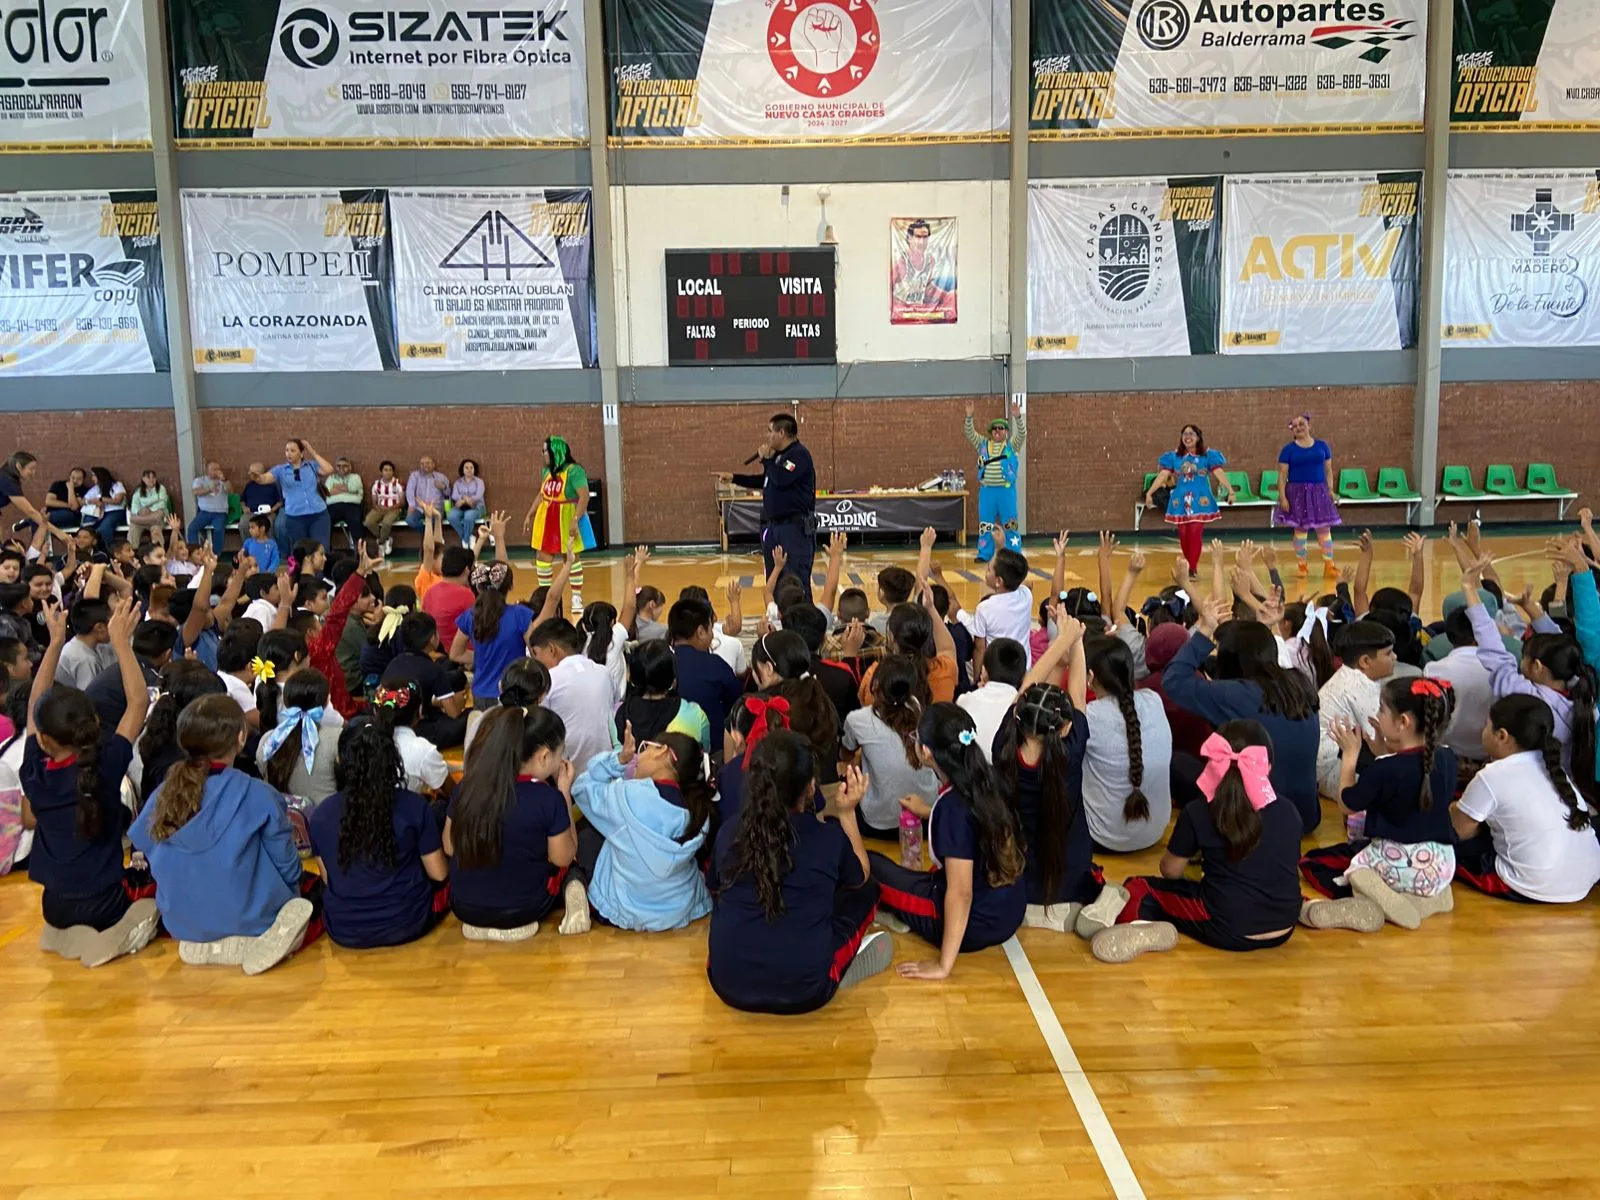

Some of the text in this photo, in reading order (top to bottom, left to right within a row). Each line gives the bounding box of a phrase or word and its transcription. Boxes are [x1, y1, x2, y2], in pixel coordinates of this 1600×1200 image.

[1194, 0, 1385, 28] Autopartes
[0, 0, 107, 63] olor
[348, 11, 569, 42] SIZATEK
[1201, 31, 1306, 47] Balderrama
[350, 46, 571, 67] Internet por Fibra Óptica
[1035, 71, 1117, 89] PATROCINADOR
[1458, 66, 1539, 82] PATROCINADOR
[184, 81, 268, 97] PATROCINADOR
[618, 79, 699, 95] PATROCINADOR
[1149, 77, 1227, 93] 636-661-3473
[1234, 75, 1307, 92] 636-694-1322
[1032, 88, 1117, 120] OFICIAL
[1454, 82, 1540, 113] OFICIAL
[183, 97, 271, 129] OFICIAL
[616, 95, 702, 127] OFICIAL
[765, 103, 814, 111] GOBIERNO
[818, 102, 868, 110] MUNICIPAL
[765, 109, 885, 119] NUEVO CASAS GRANDES
[99, 214, 160, 237] OFICIAL
[1087, 202, 1163, 263] CASAS GRANDES
[213, 251, 372, 277] POMPEII
[1511, 264, 1569, 274] MADERO
[423, 285, 574, 296] CLINICA HOSPITAL DUBLAN
[677, 279, 722, 295] LOCAL
[780, 278, 822, 295] VISITA
[95, 290, 137, 305] copy
[434, 298, 564, 311] TU SALUD ES NUESTRA PRIORIDAD
[222, 315, 367, 328] LA CORAZONADA
[733, 318, 769, 328] PERIODO
[686, 325, 716, 338] FALTAS
[785, 324, 821, 337] FALTAS
